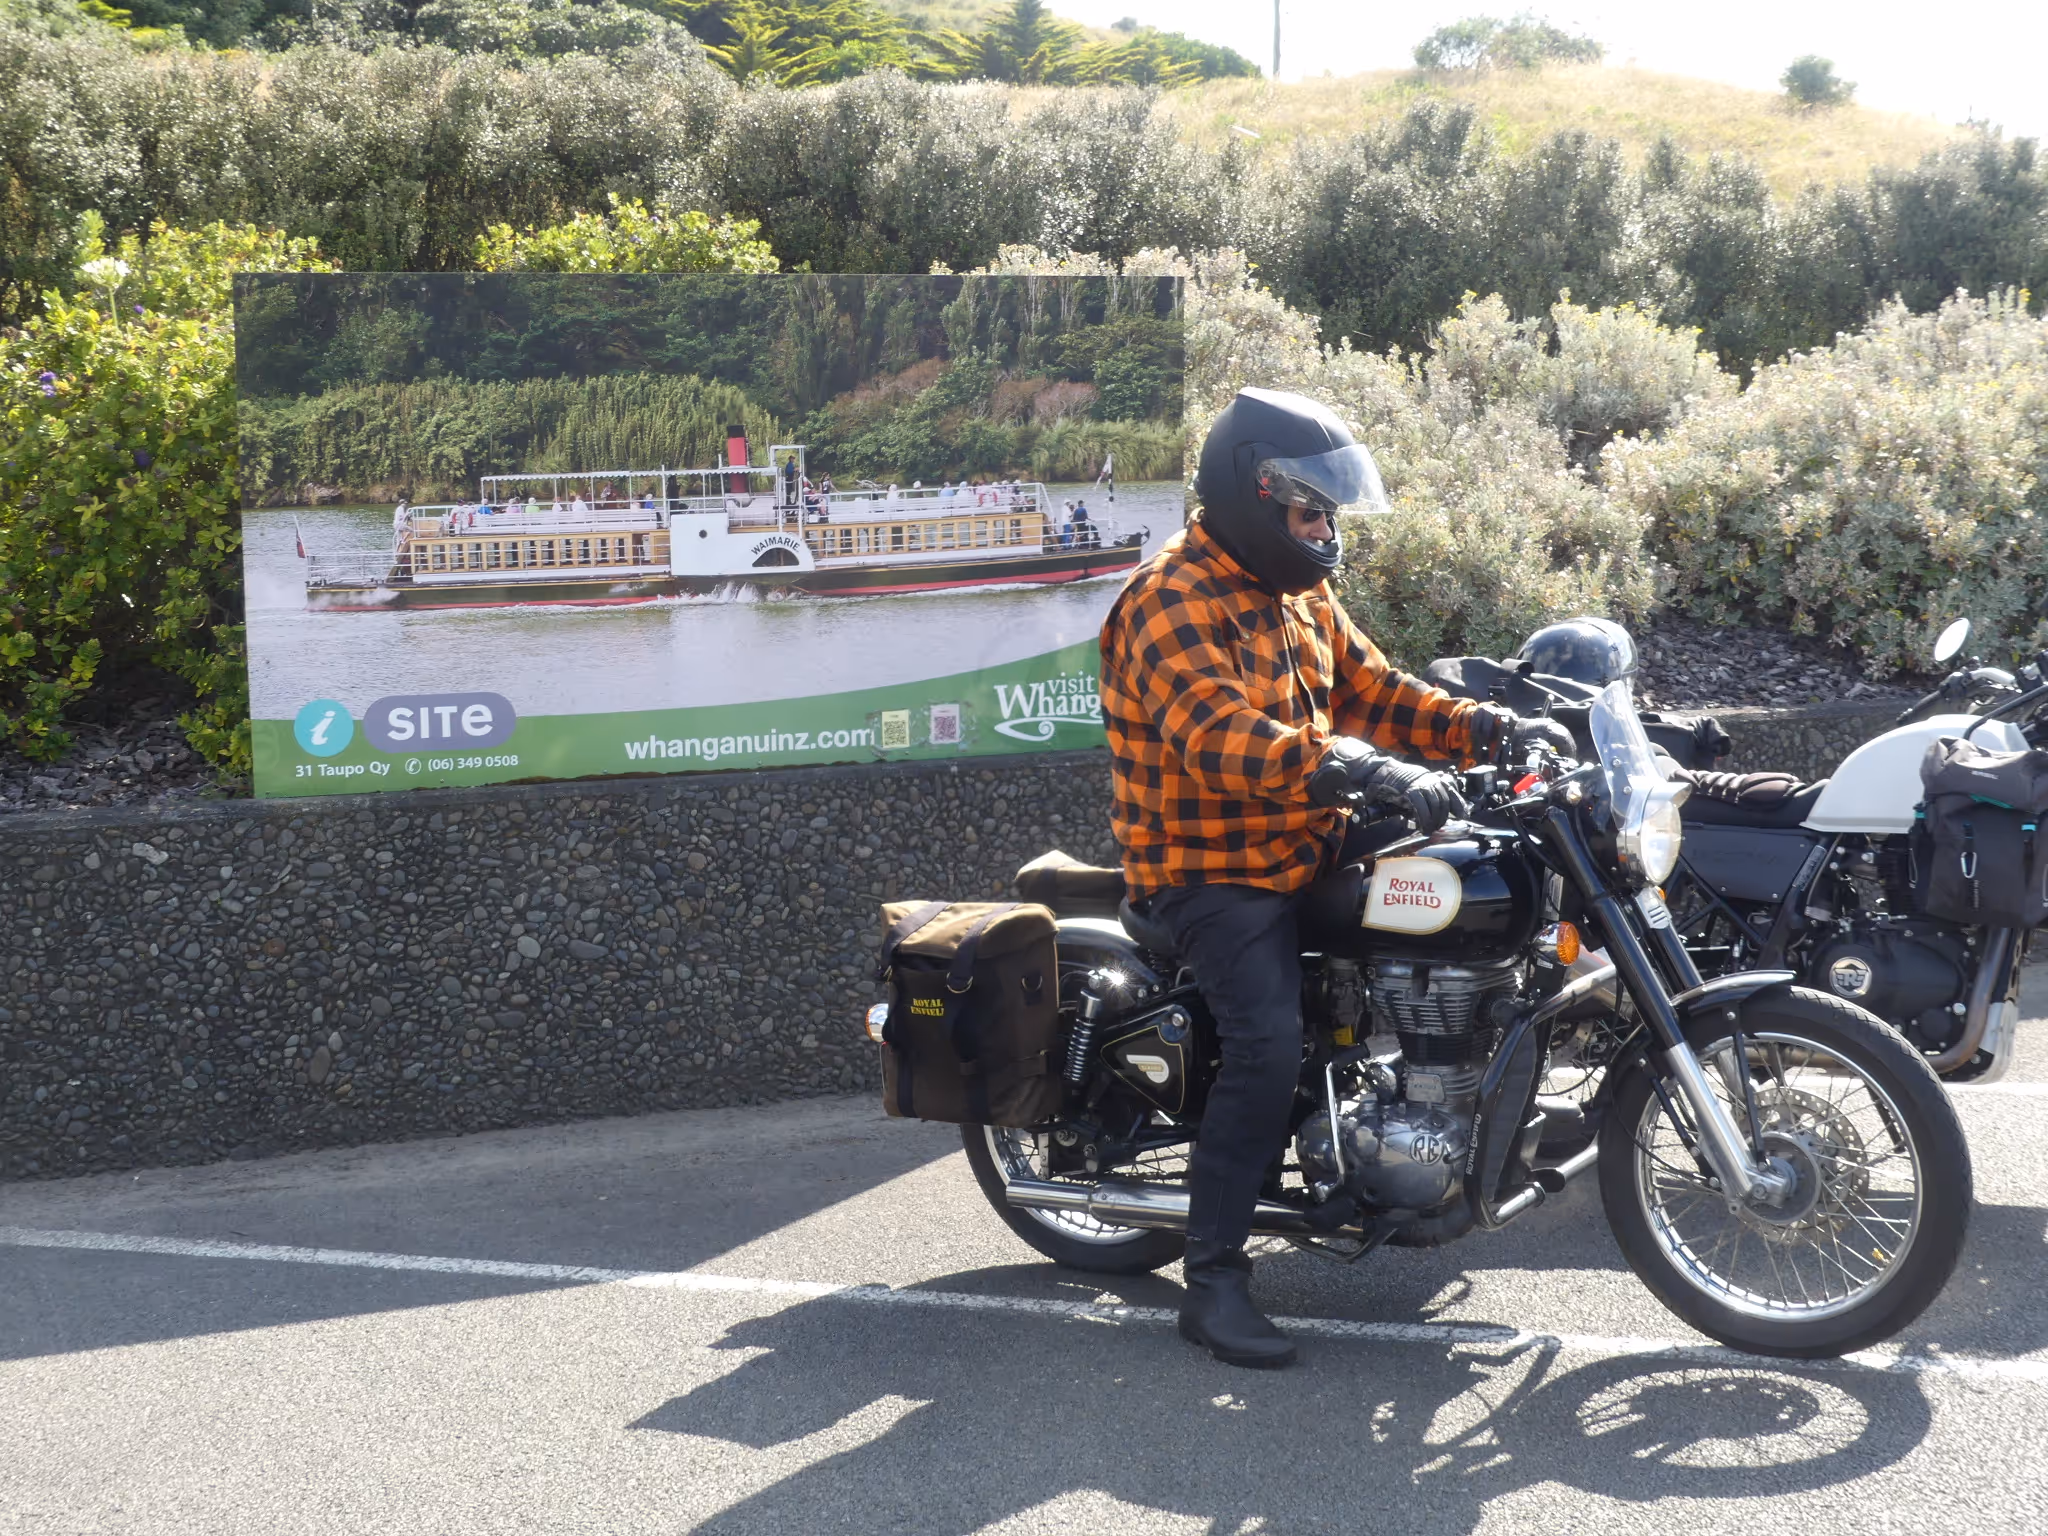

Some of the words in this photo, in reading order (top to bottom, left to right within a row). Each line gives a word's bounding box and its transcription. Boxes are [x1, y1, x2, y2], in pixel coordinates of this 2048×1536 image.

[750, 536, 800, 555] WAIMARIE
[1047, 670, 1095, 694] visit
[993, 682, 1102, 719] Whang
[624, 728, 875, 761] whanganuinz.com
[295, 765, 312, 777] 31
[318, 764, 364, 778] Taupo
[369, 761, 390, 776] Qy
[428, 758, 454, 772] (06)
[457, 757, 482, 769] 349
[485, 755, 519, 767] 0508
[1389, 878, 1435, 892] ROYAL
[1383, 893, 1441, 908] ENFIELD
[912, 998, 943, 1007] ROYAL
[1465, 1148, 1476, 1175] ROYAL
